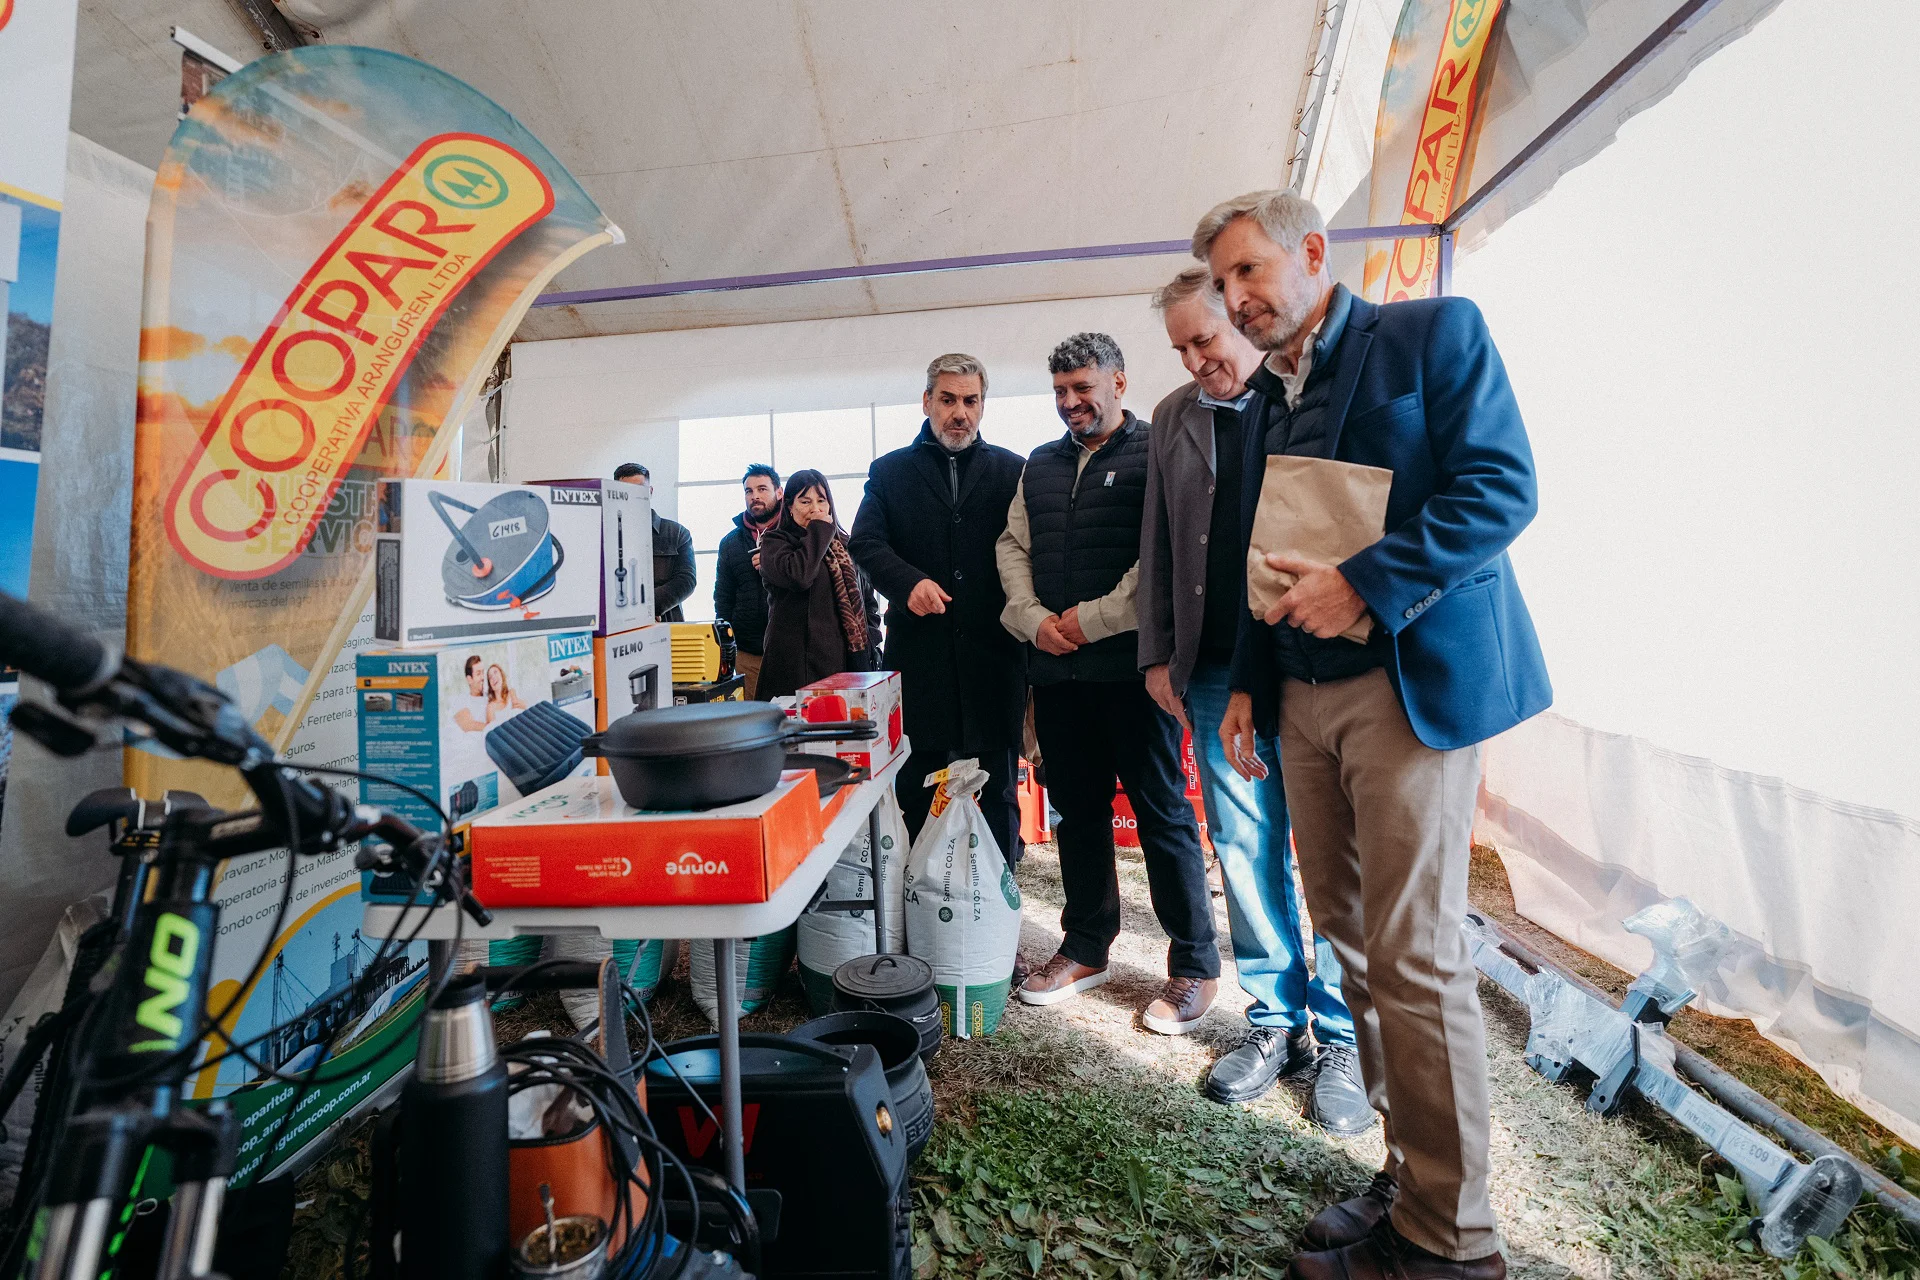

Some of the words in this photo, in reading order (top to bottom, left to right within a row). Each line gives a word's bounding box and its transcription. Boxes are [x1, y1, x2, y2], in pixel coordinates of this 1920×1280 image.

[1390, 57, 1472, 304] OPAR
[189, 199, 476, 542] COOPAR
[283, 399, 364, 525] COOPERATIVA
[356, 288, 435, 399] ARANGUREN
[428, 252, 472, 291] LTDA
[552, 488, 599, 504] INTEX
[607, 489, 629, 501] YELMO
[243, 518, 375, 554] SERVIC
[228, 581, 259, 593] Venta
[261, 580, 277, 591] de
[342, 637, 374, 649] eaginos
[550, 634, 591, 659] INTEX
[612, 640, 644, 659] YELMO
[387, 661, 429, 674] INTEX
[322, 687, 344, 701] para
[345, 684, 357, 695] tra
[284, 741, 316, 760] guros
[1111, 815, 1138, 829] ólo
[944, 837, 957, 867] COLZA
[220, 857, 267, 883] ravanz:
[665, 857, 729, 876] vonne
[856, 873, 865, 898] Semil
[861, 832, 871, 863] COLZA
[969, 852, 979, 887] Semilla
[295, 887, 309, 901] de
[943, 869, 953, 902] Semilla
[972, 889, 981, 922] COLZA
[128, 912, 199, 1054] NO
[241, 1085, 294, 1128] oparltda
